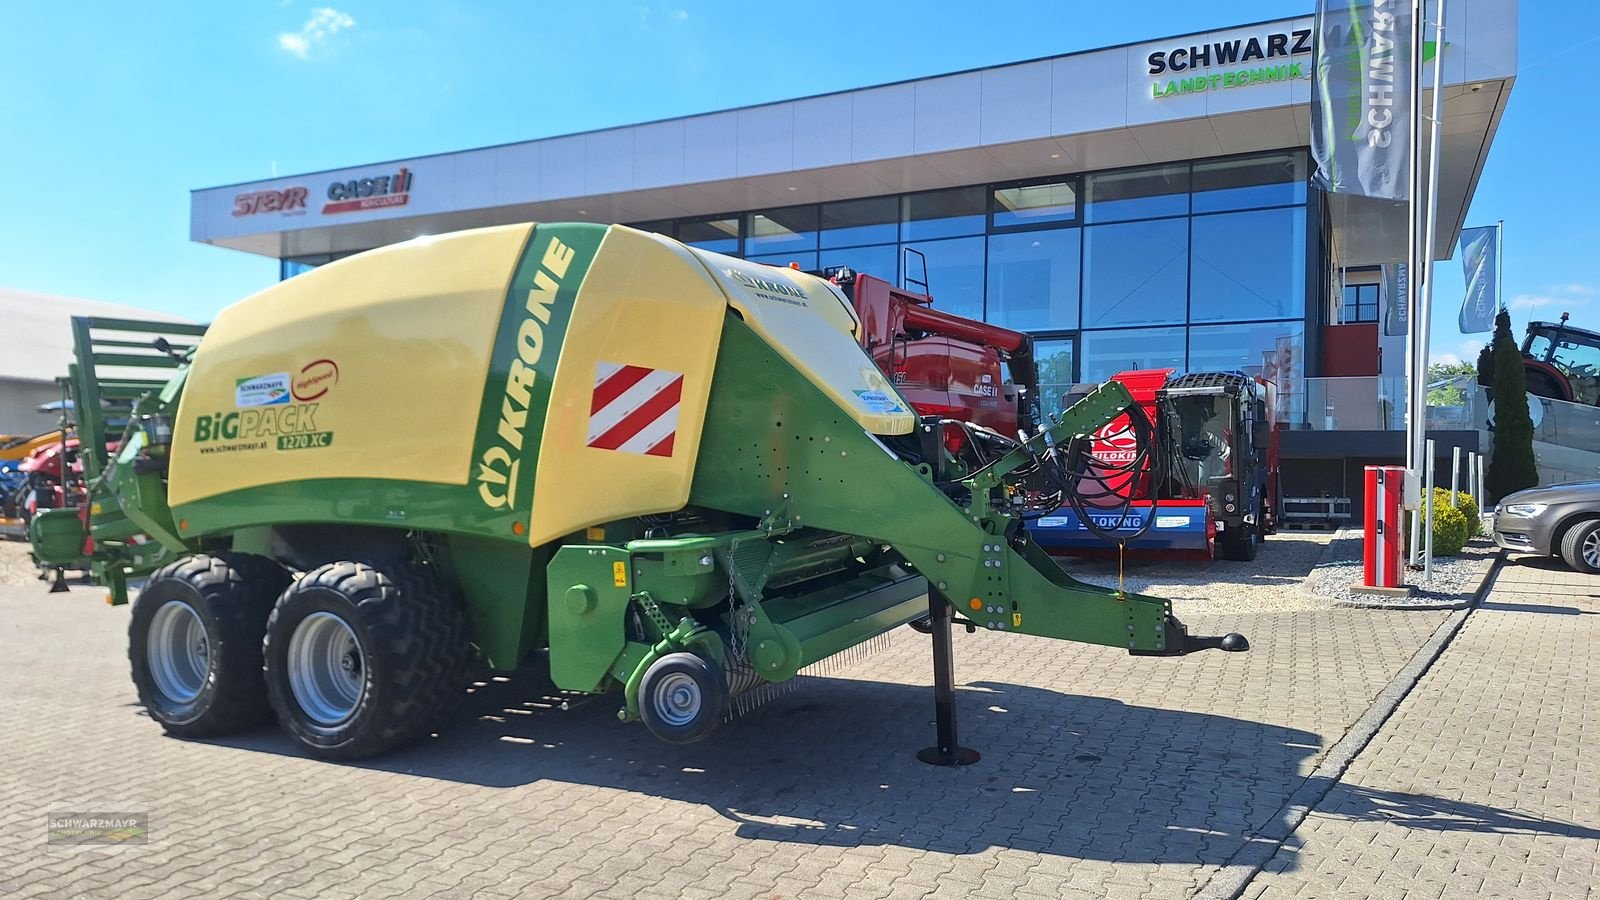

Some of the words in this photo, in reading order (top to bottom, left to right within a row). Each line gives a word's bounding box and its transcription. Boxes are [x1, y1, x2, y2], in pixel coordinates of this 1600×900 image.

[1148, 25, 1341, 76] SCHWARZ
[1152, 63, 1303, 97] LANDTECHNIK
[328, 175, 390, 201] CASE
[232, 187, 307, 216] STEYR
[751, 278, 808, 299] KRONE
[498, 236, 576, 451] KRONE
[974, 384, 992, 396] CASE
[200, 441, 267, 454] www.schwarzmayr.at
[281, 436, 307, 449] 1270
[311, 435, 328, 447] XC
[1092, 452, 1137, 460] SILOKIN
